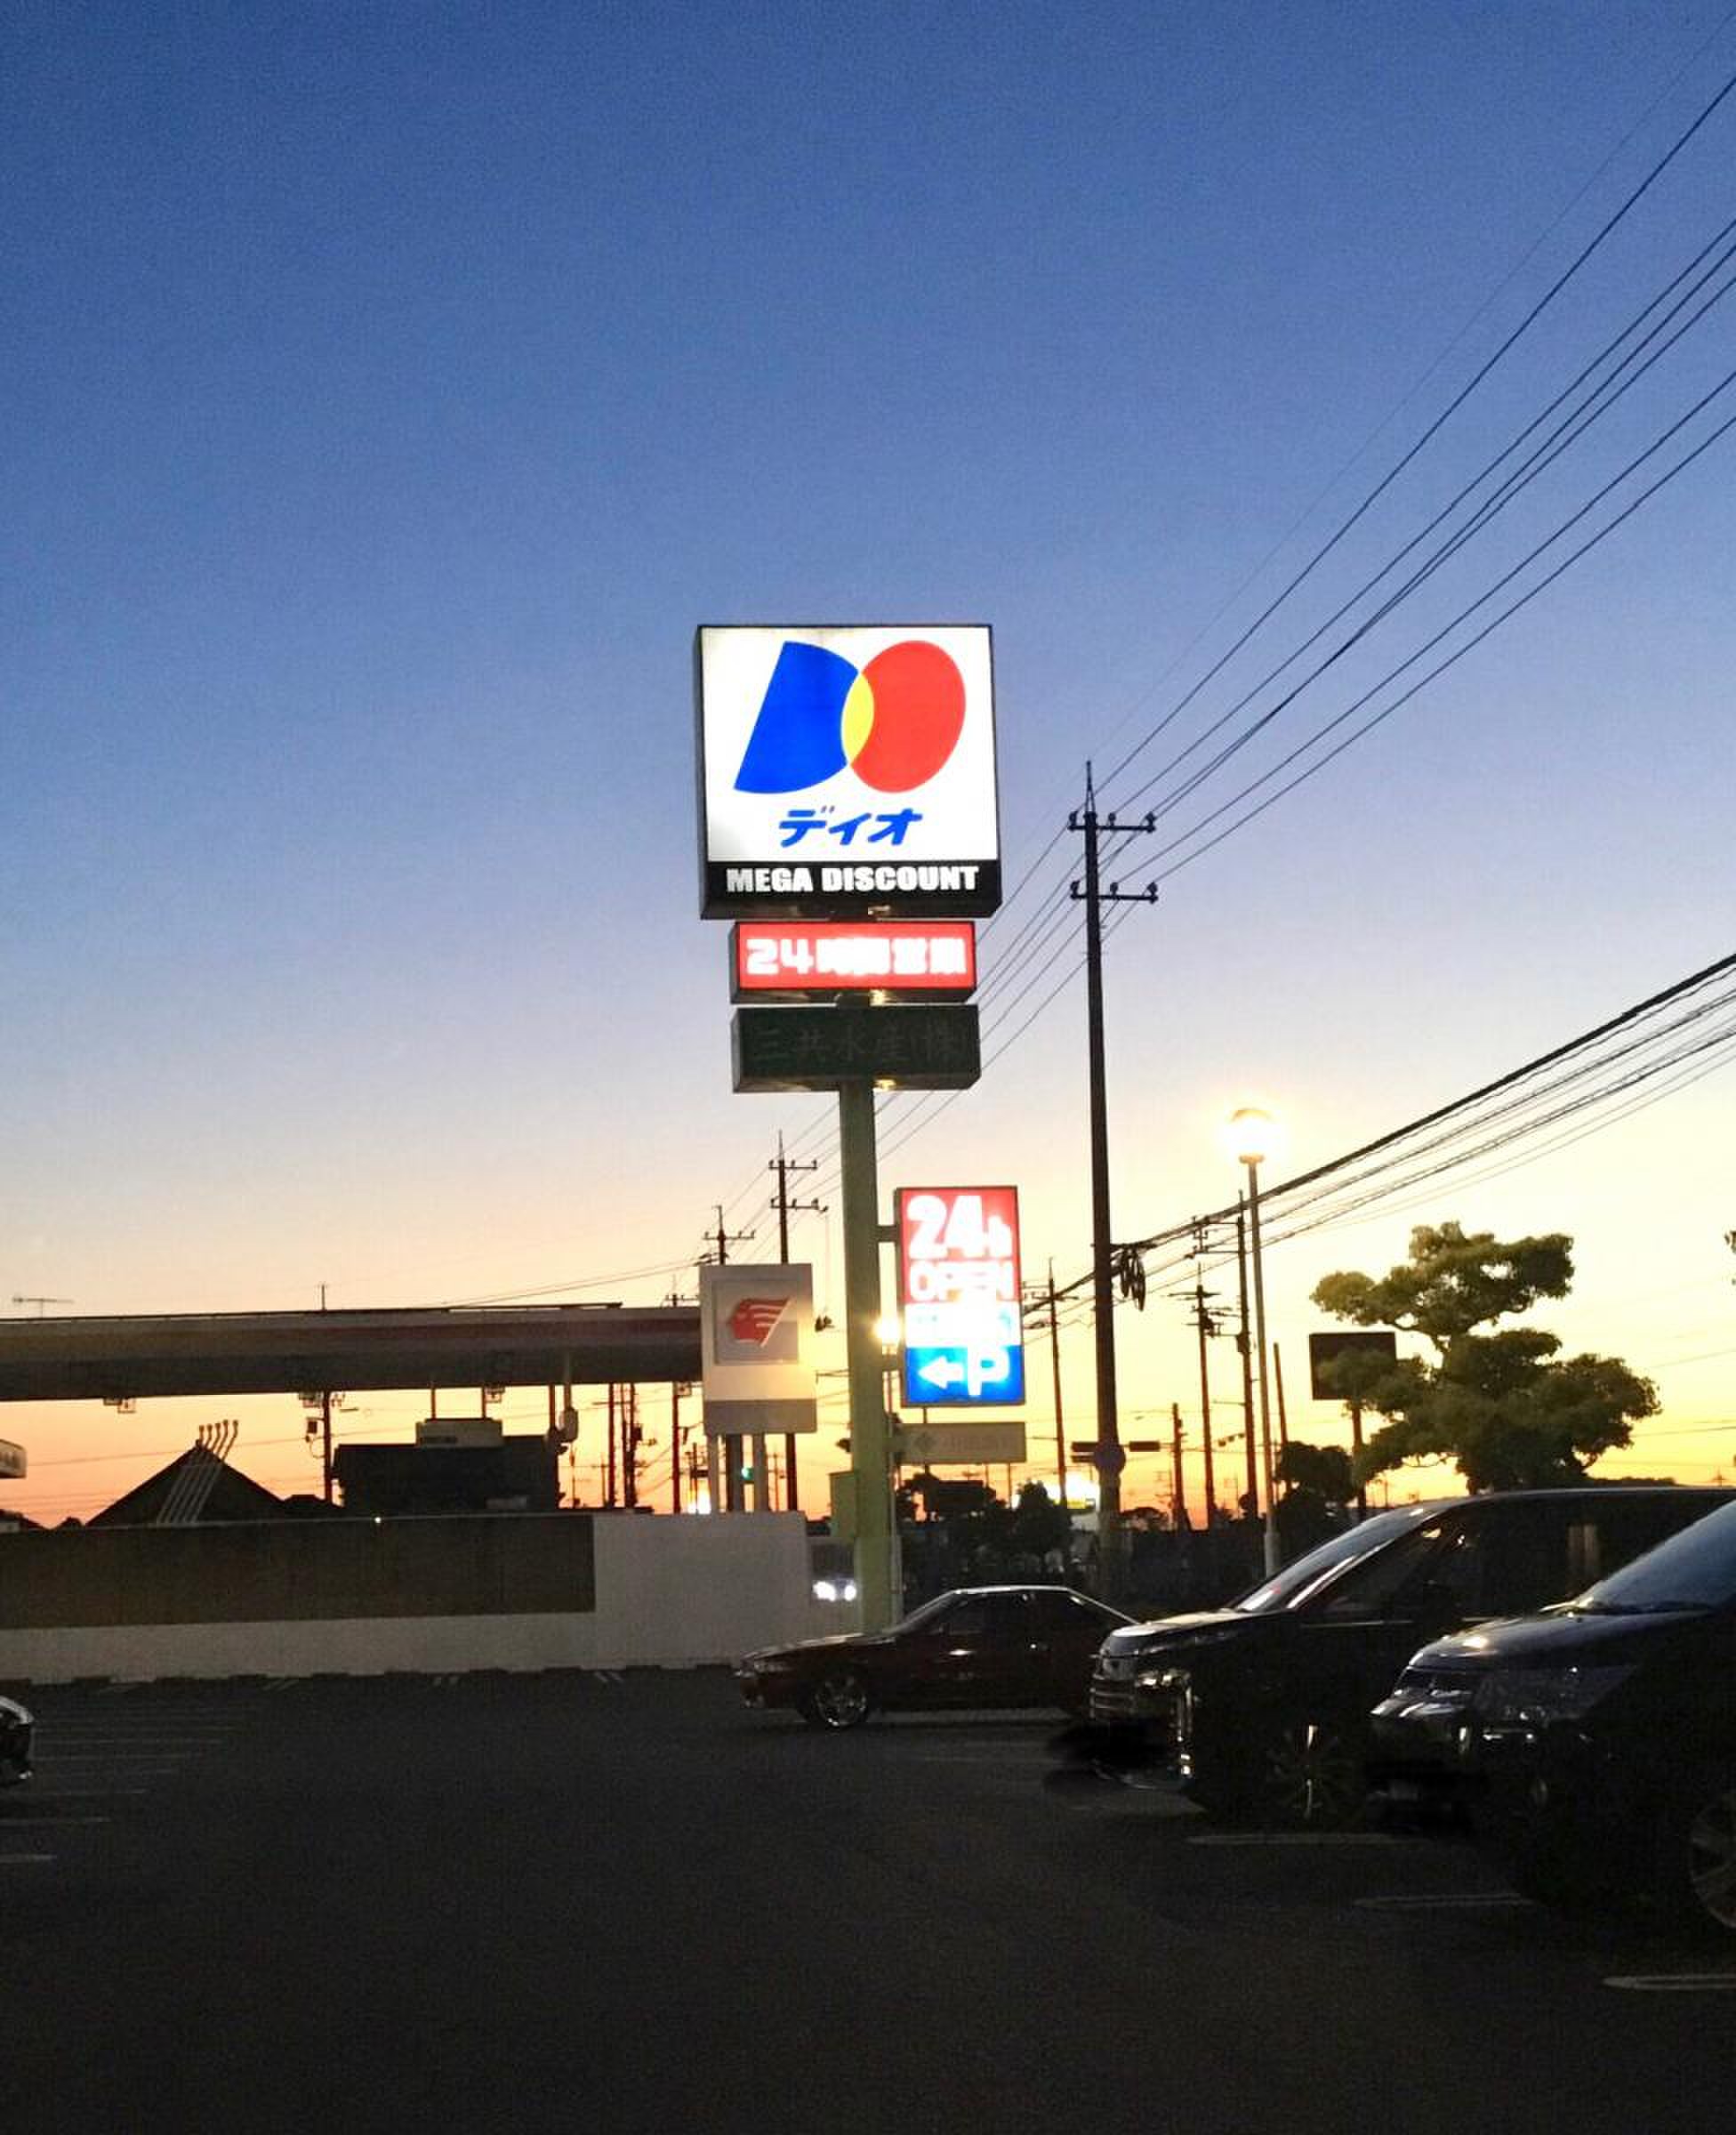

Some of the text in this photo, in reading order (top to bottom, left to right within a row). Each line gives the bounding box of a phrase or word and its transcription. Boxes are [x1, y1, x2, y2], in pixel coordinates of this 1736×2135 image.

[778, 805, 923, 848] ディオ
[726, 866, 979, 893] MEGA DISCOUNT
[967, 1347, 1010, 1397] P
